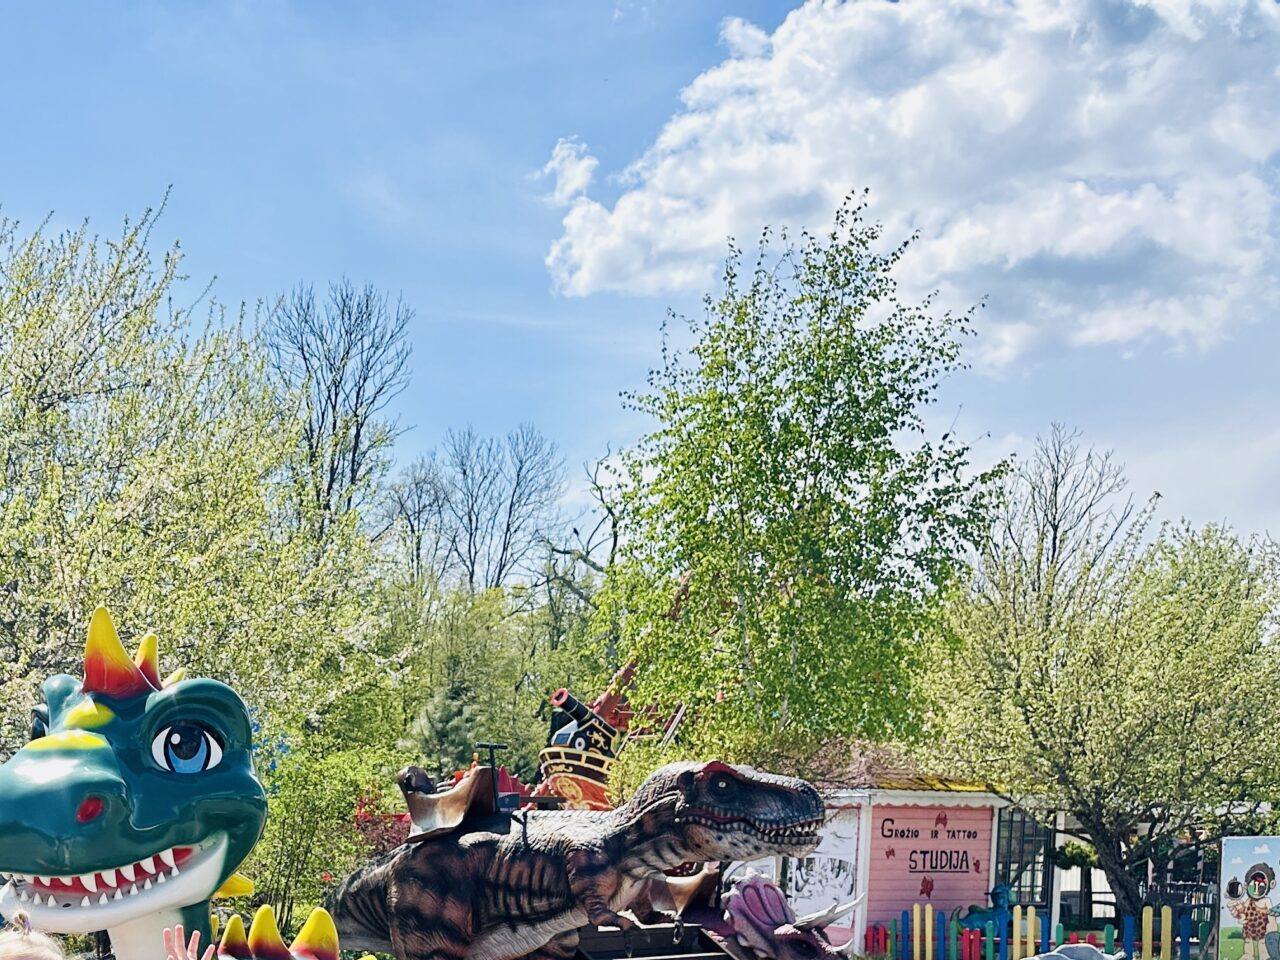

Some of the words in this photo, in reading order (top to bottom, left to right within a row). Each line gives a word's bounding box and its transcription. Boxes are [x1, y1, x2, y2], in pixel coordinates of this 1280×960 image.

[931, 830, 939, 839] IR
[946, 829, 978, 839] TATTOO
[908, 850, 970, 870] STUDIJA
